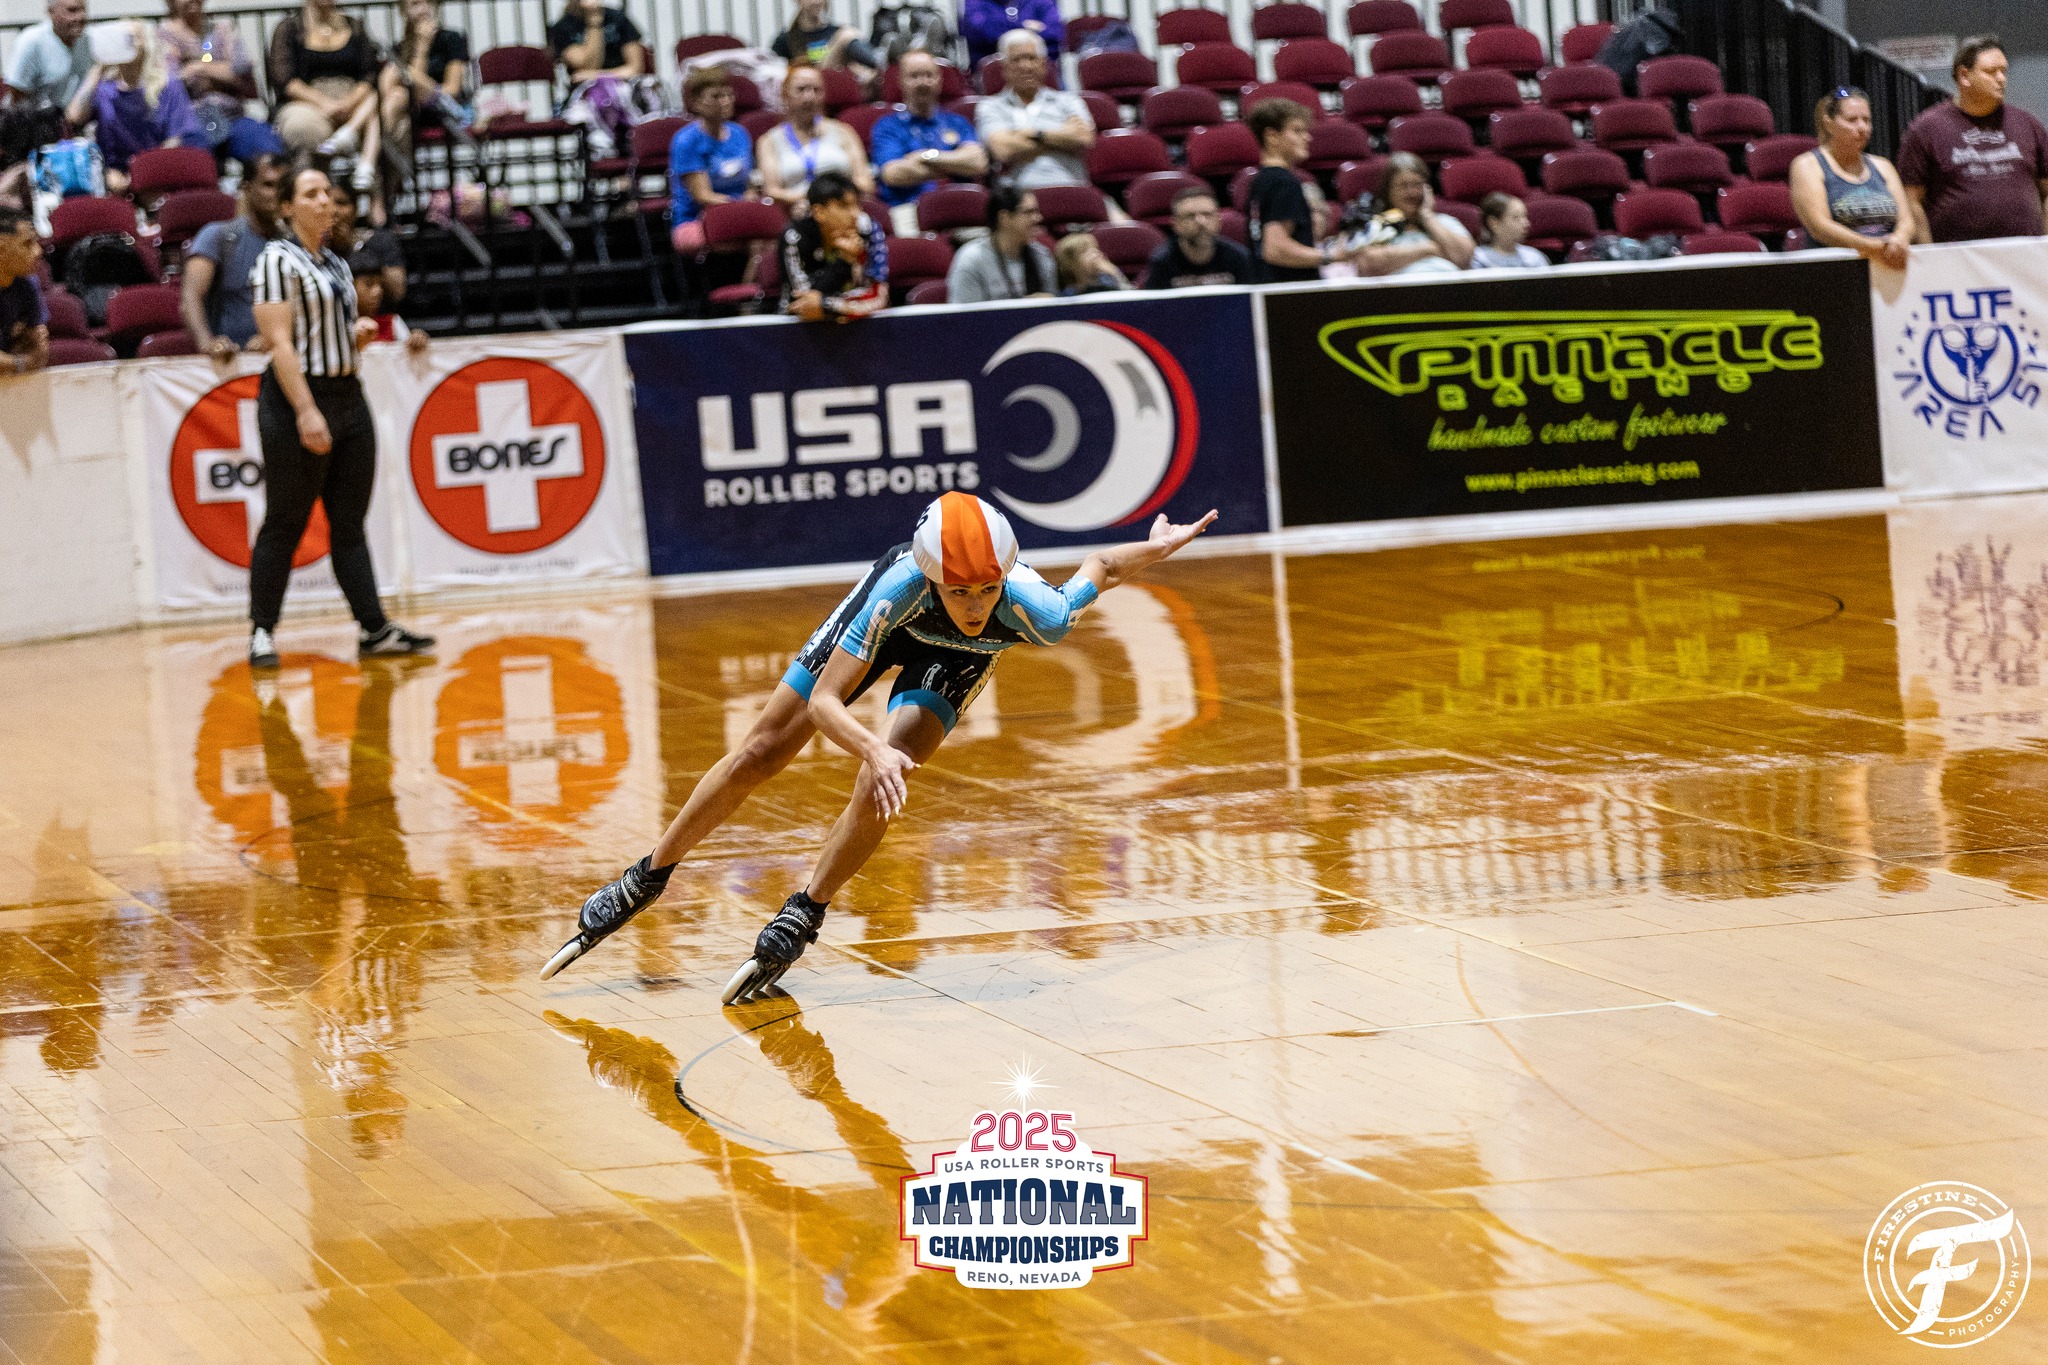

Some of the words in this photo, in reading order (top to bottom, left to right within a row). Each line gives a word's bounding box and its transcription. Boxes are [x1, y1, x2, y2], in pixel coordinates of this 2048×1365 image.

[1922, 290, 2012, 322] TUF
[697, 379, 978, 471] USA
[448, 436, 566, 474] BONES
[703, 470, 837, 507] ROLLER
[845, 460, 980, 498] SPORTS
[1464, 459, 1700, 494] www.pinnacleracing.com
